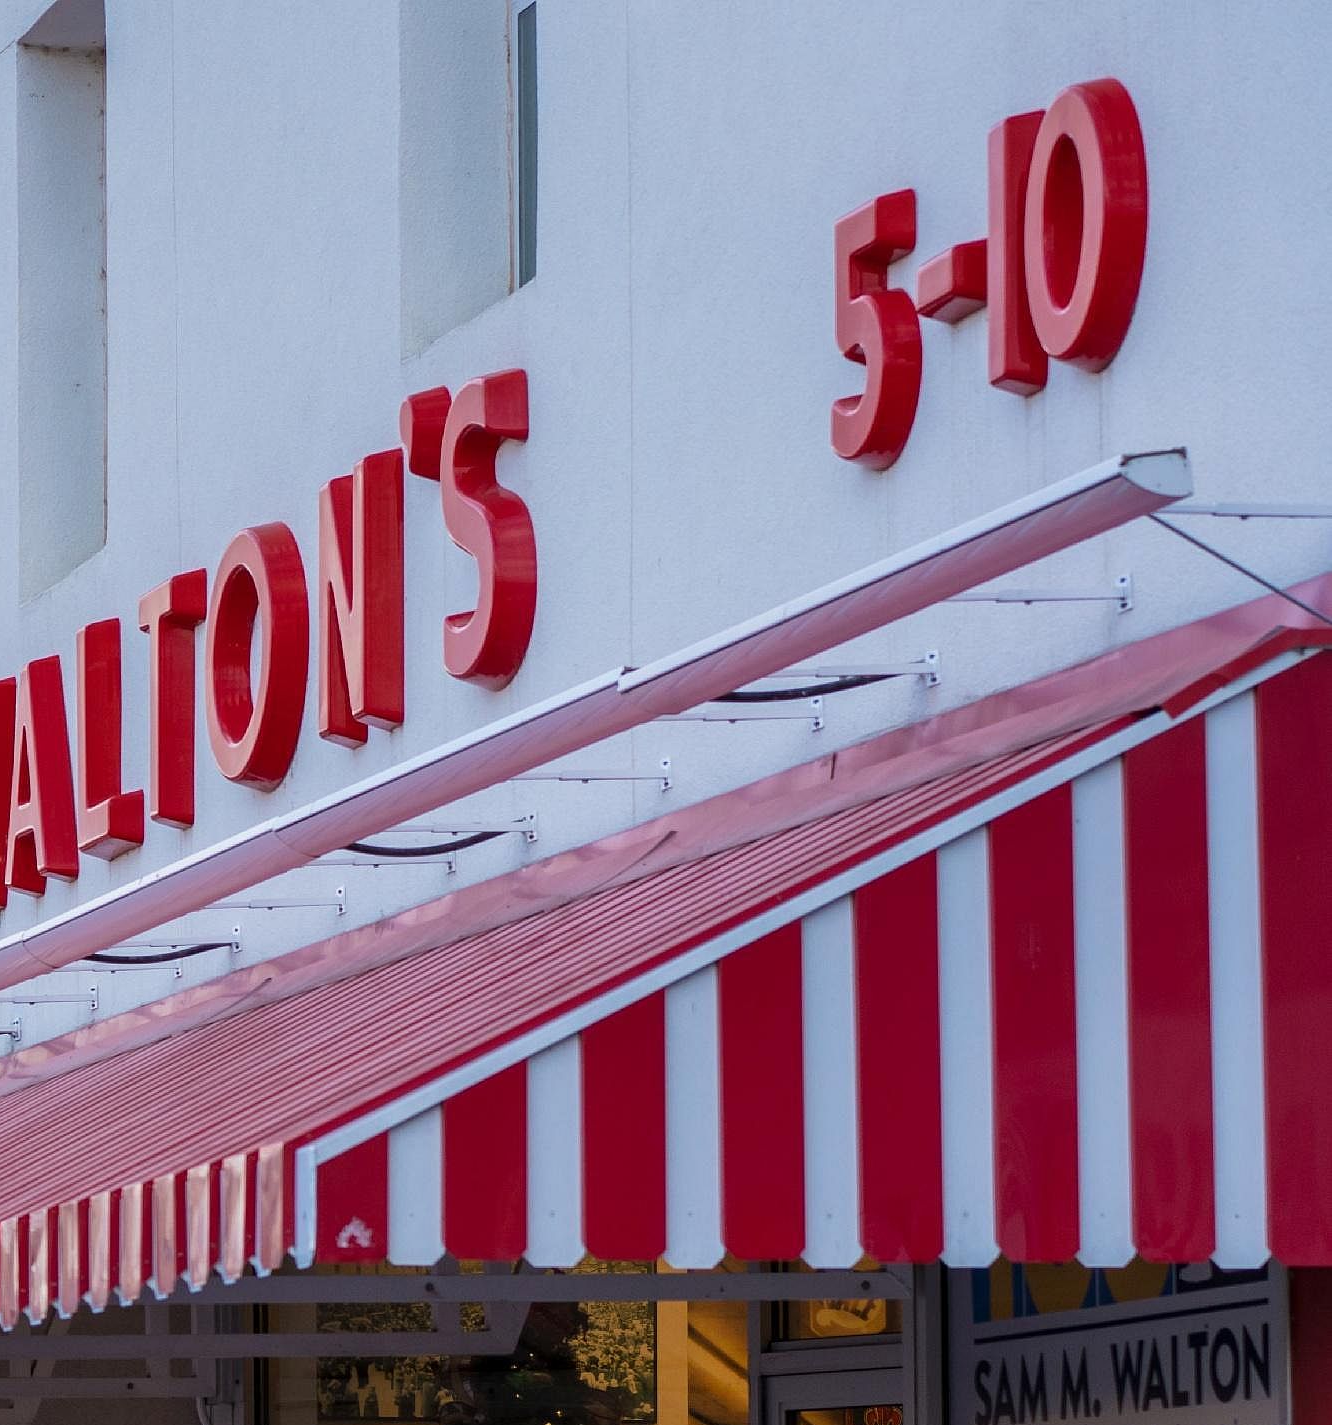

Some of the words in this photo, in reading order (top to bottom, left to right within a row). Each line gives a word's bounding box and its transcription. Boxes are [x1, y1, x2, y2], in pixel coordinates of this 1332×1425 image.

[830, 76, 1149, 472] 5-10
[1060, 1346, 1101, 1421] M.
[1111, 1323, 1271, 1416] WALTON
